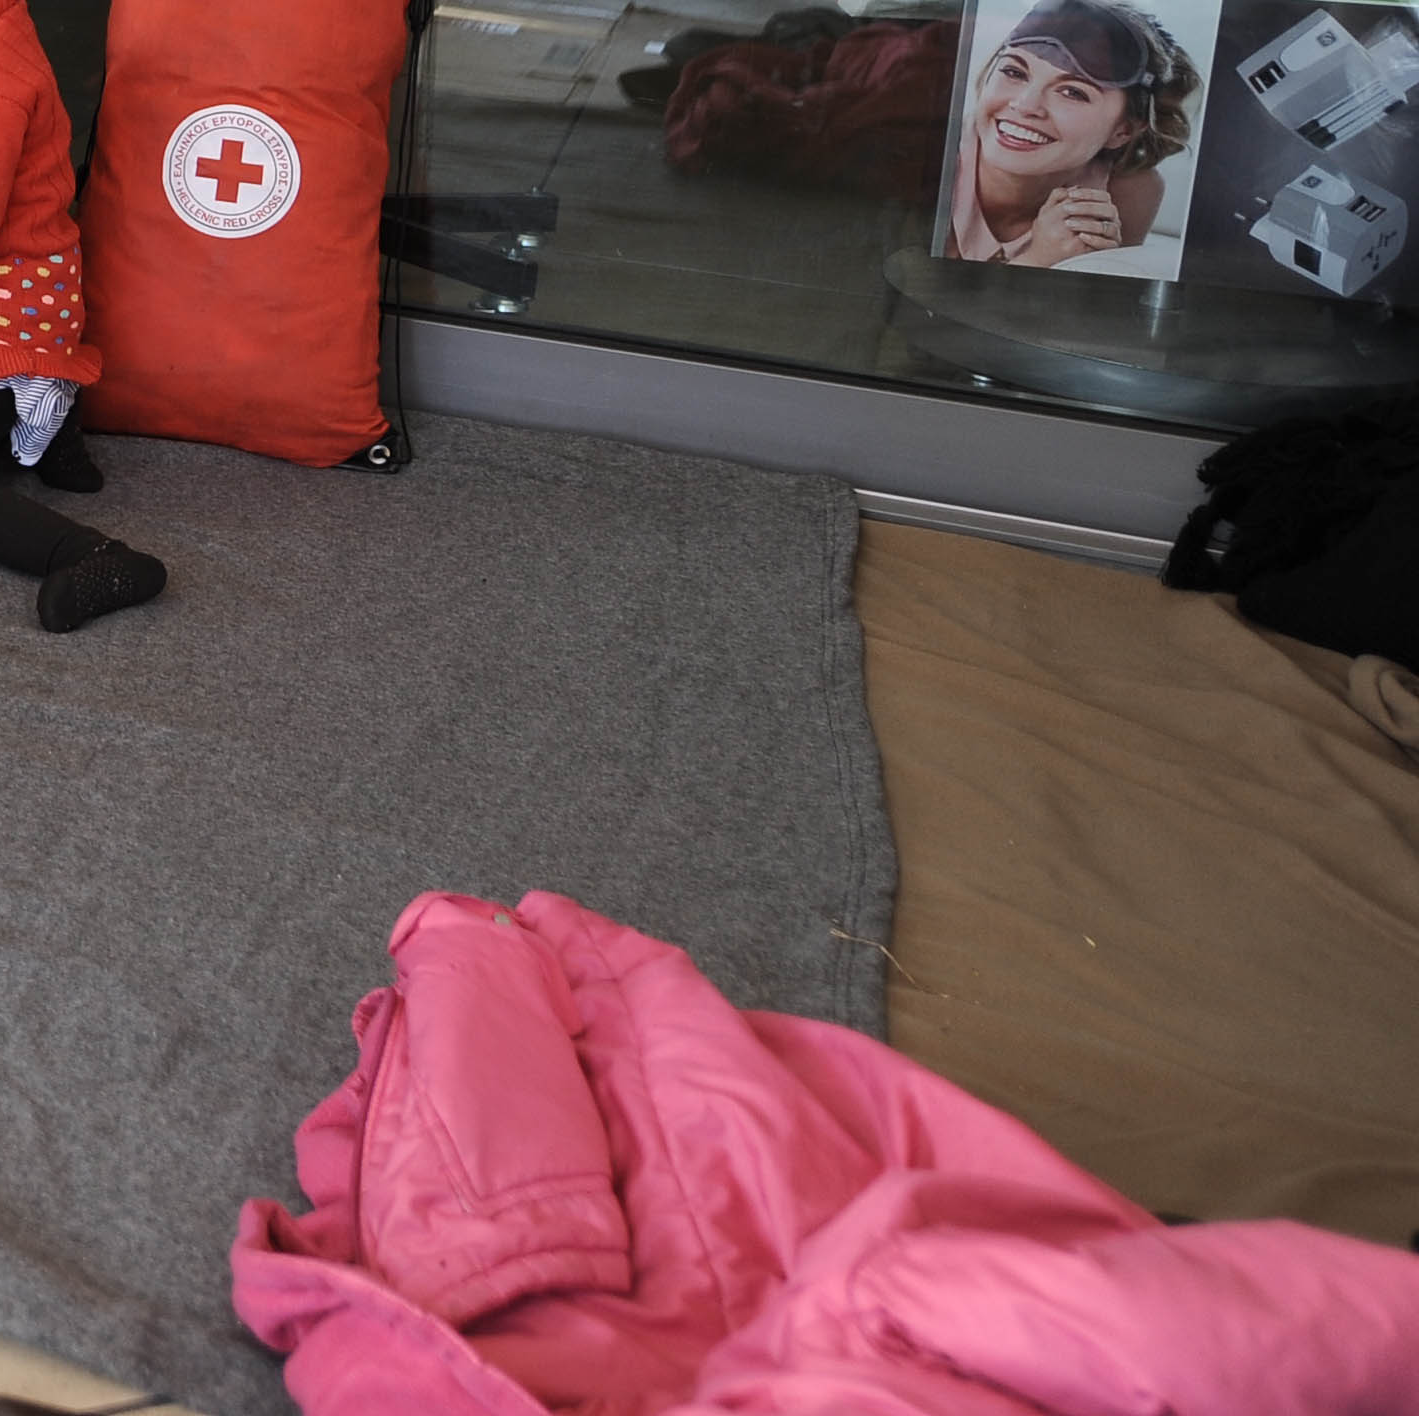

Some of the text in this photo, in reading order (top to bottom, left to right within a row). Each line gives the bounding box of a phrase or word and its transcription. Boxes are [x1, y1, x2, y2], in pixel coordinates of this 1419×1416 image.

[174, 121, 209, 178] ΕΛΛΗΝΙΚΟΣ
[176, 188, 282, 228] HELLENIC RED CROSS
